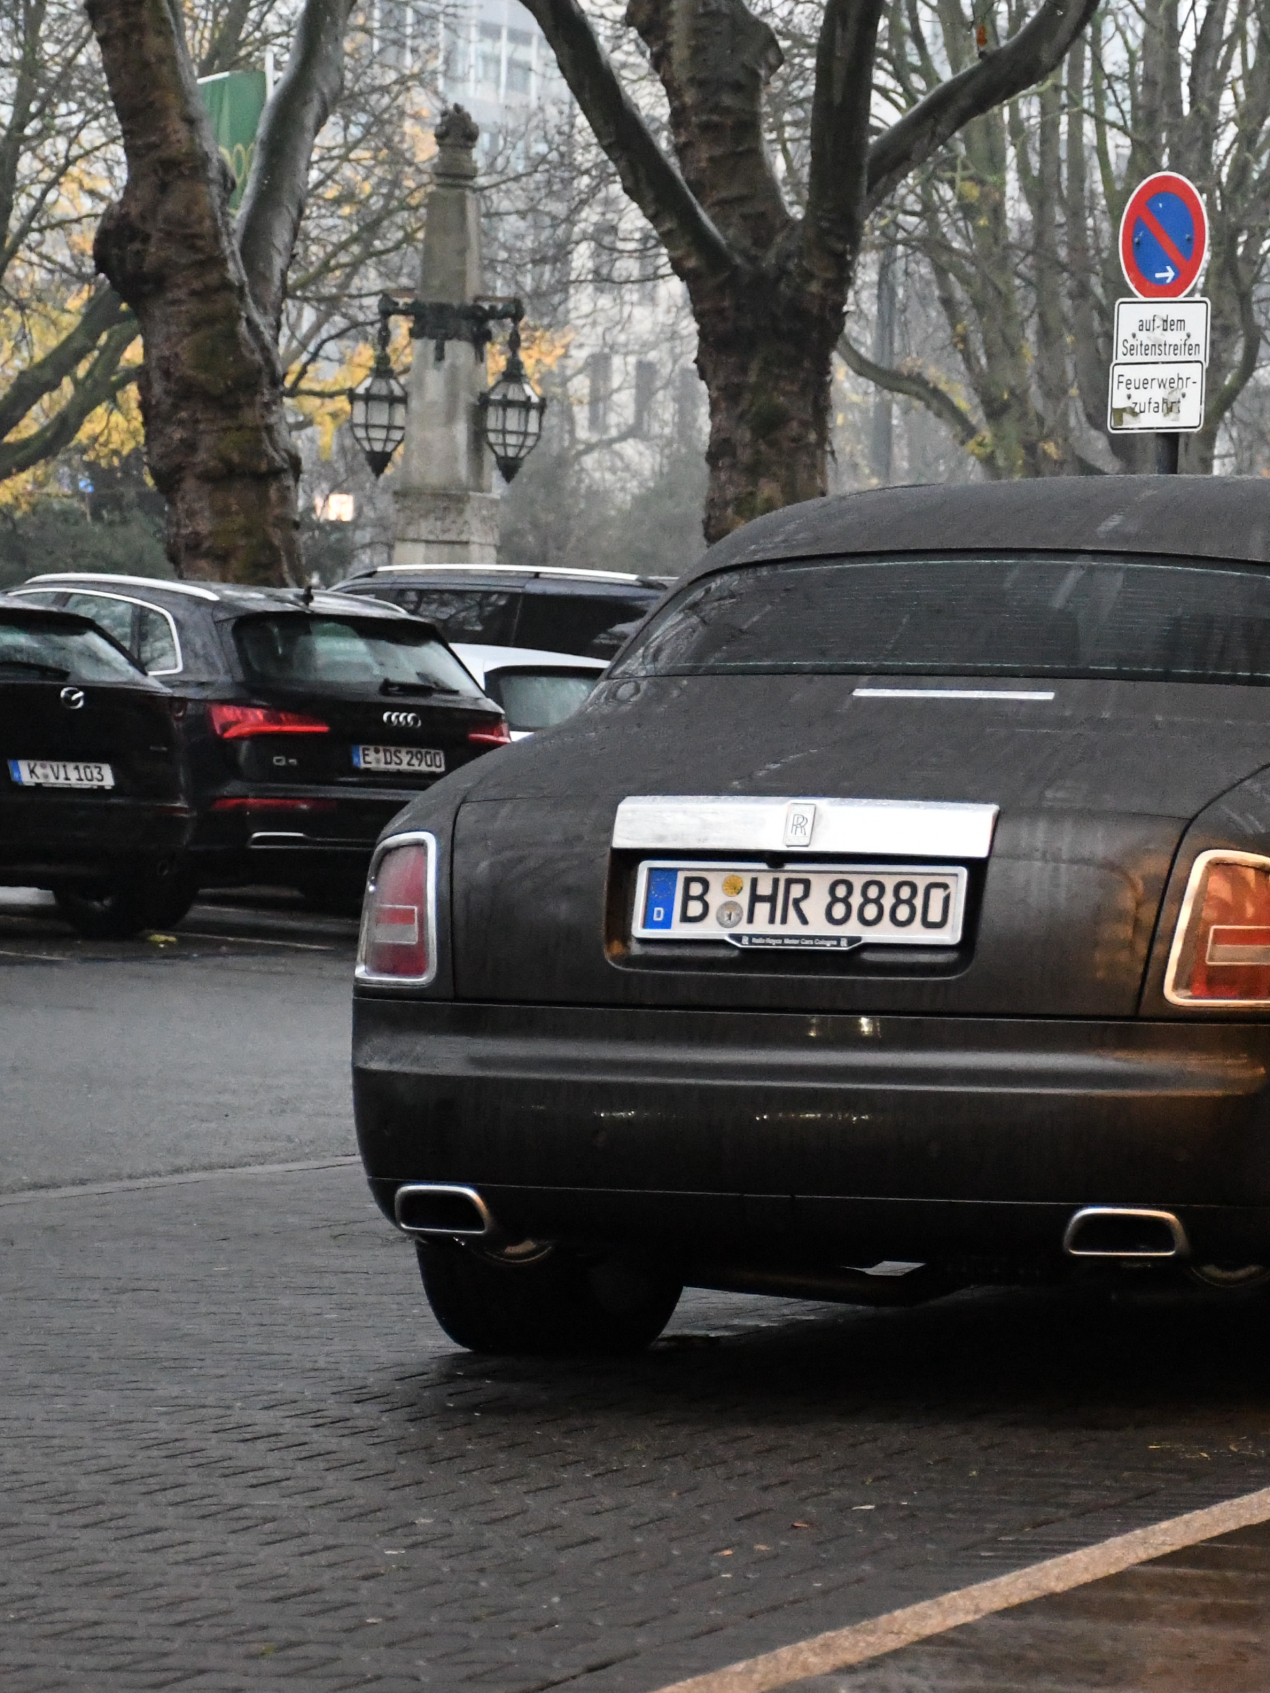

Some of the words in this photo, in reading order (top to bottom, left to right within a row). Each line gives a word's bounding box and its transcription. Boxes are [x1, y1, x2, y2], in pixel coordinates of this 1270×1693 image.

[1138, 315, 1157, 332] auf
[1162, 315, 1186, 332] dem
[1121, 338, 1201, 357] Seitenstreifen
[1117, 373, 1198, 391] Feuerwehr-
[1131, 396, 1181, 414] zufahrt
[406, 750, 443, 769] 2900
[73, 764, 104, 782] 103
[681, 876, 711, 922] B
[747, 877, 811, 925] HR
[824, 879, 952, 929] 8880
